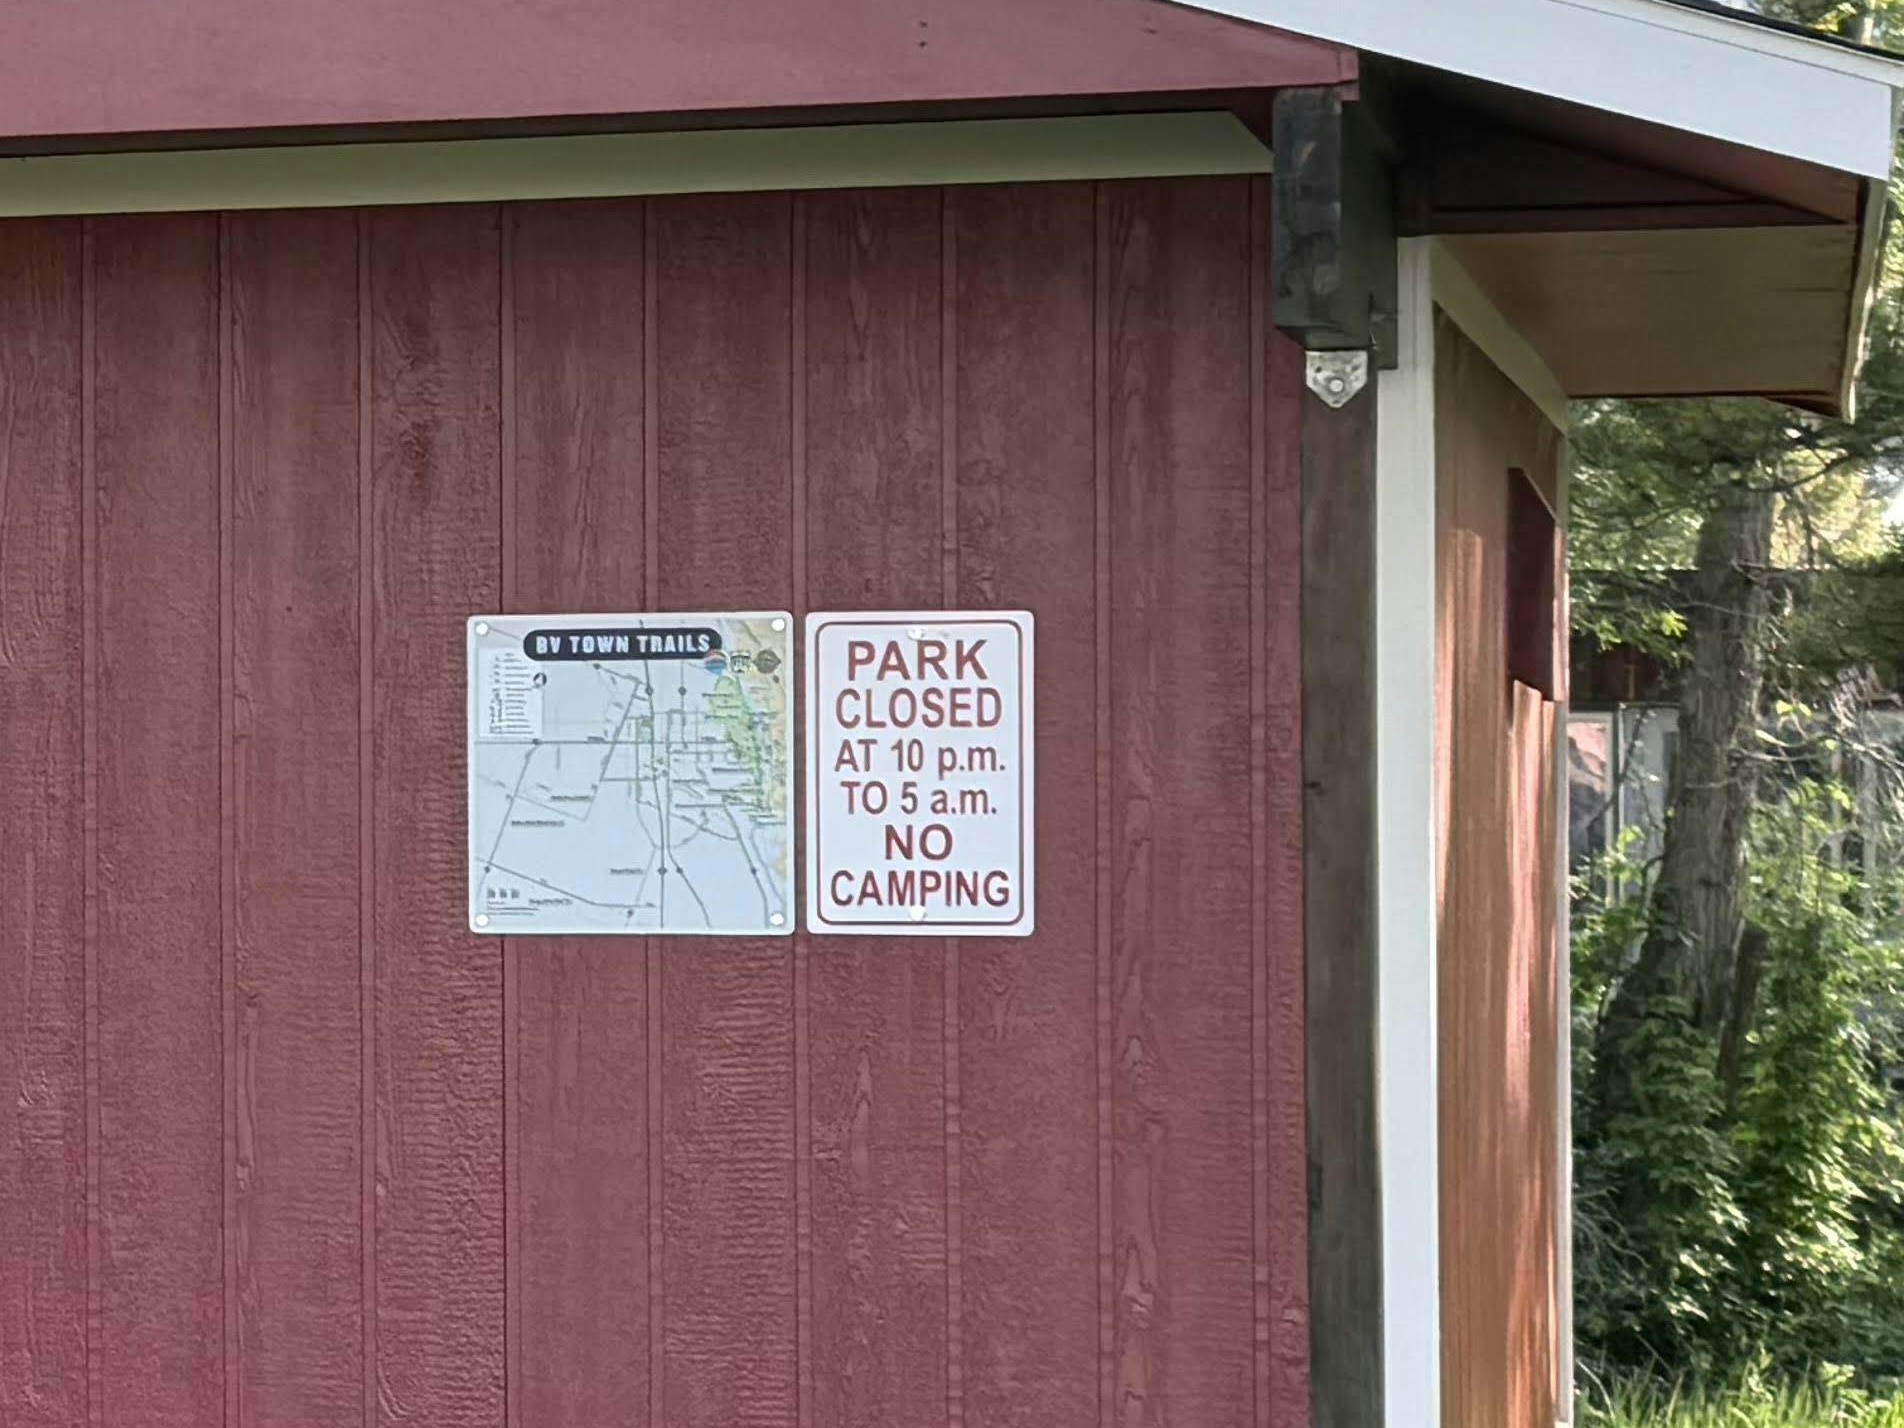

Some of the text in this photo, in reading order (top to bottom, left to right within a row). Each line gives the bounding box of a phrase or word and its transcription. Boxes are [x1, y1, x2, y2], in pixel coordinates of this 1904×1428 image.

[536, 634, 711, 655] BV TOWN TRAILS
[848, 640, 988, 681] PARK
[835, 687, 1002, 729] CLOSED
[835, 739, 1006, 781] AT 10 p.m.
[840, 780, 998, 814] TO 5 a.m.
[885, 823, 953, 861] NO
[830, 870, 1010, 907] CAMPING
